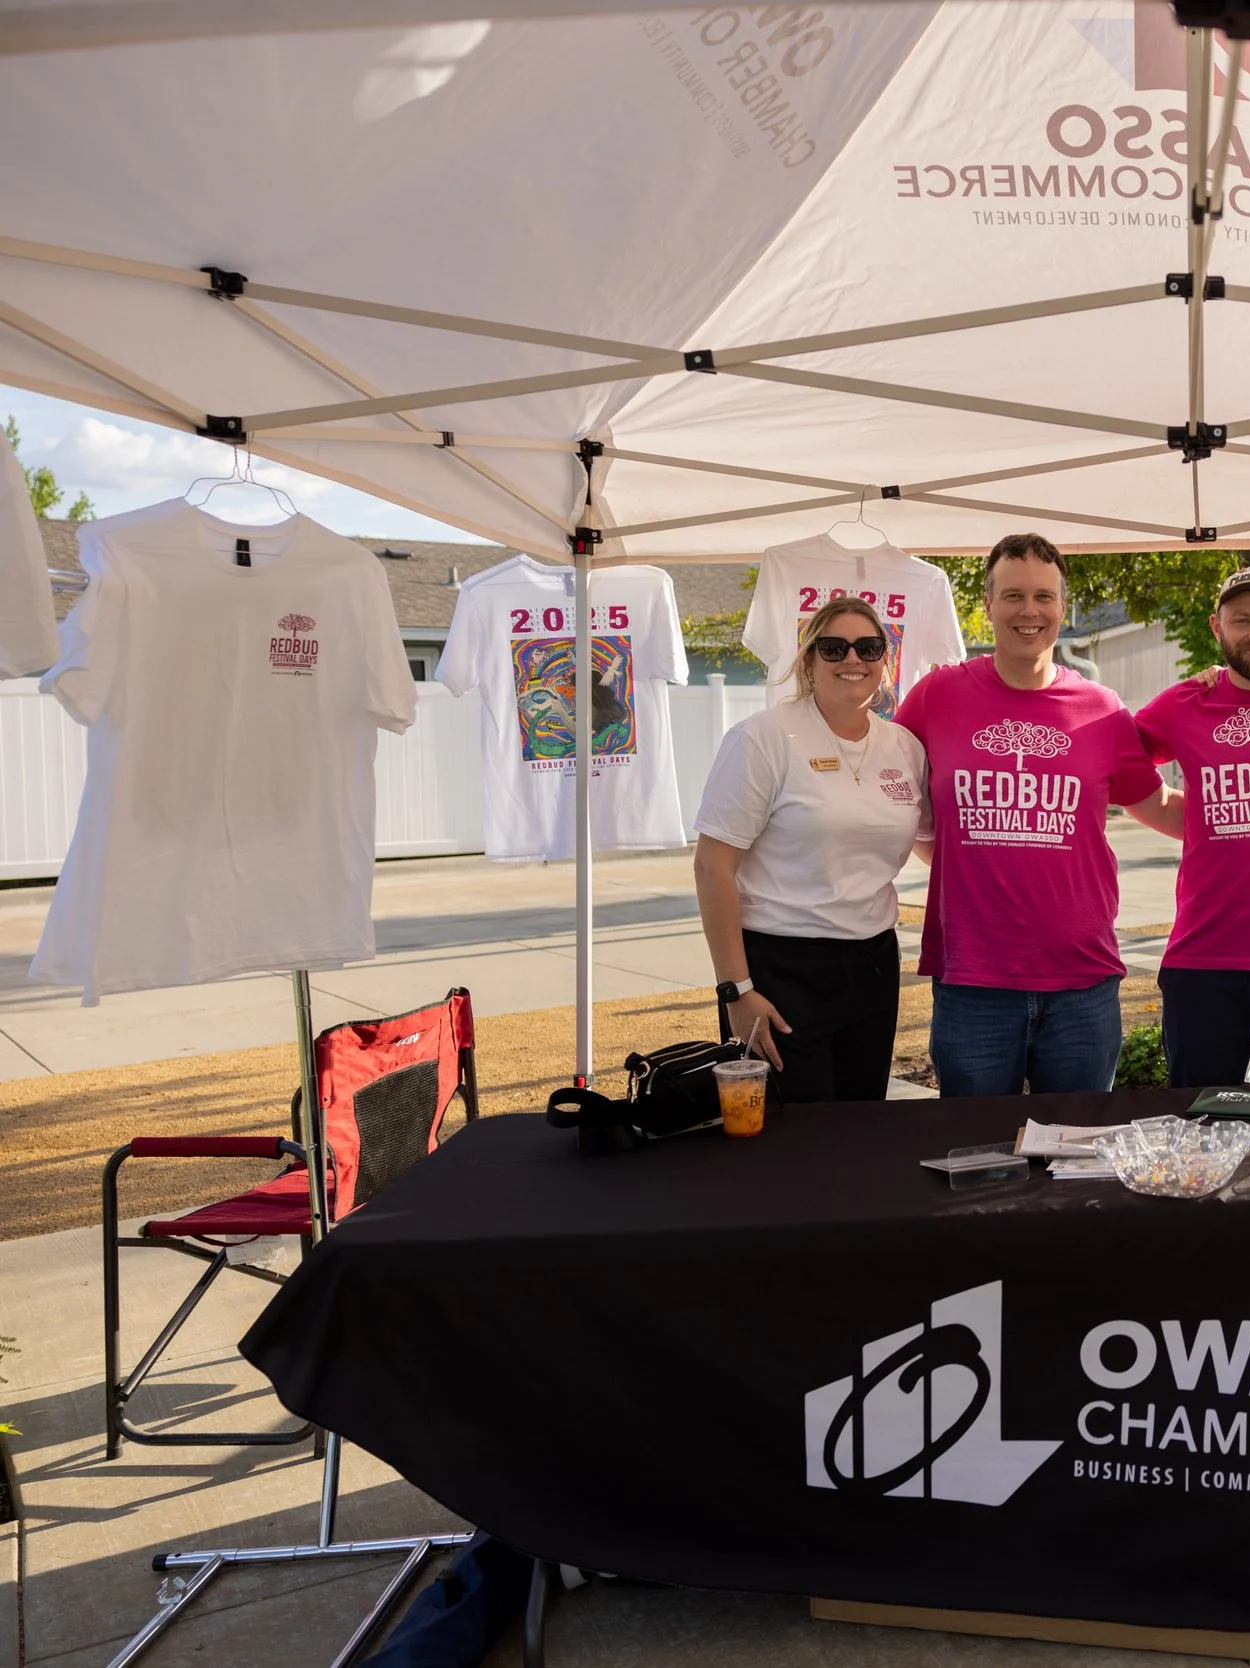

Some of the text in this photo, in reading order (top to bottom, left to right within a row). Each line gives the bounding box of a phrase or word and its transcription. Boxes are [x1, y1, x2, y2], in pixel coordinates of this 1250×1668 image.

[269, 638, 318, 655] REDBUD
[269, 653, 297, 664] FESTIVAL
[299, 654, 318, 665] DAYS
[533, 761, 564, 770] REDBUD
[954, 769, 1081, 813] REDBUD
[959, 807, 1076, 835] FESTIVAL DAYS
[970, 832, 1060, 842] DOWNTOWN OWASSO
[1074, 1460, 1174, 1486] BUSINESS
